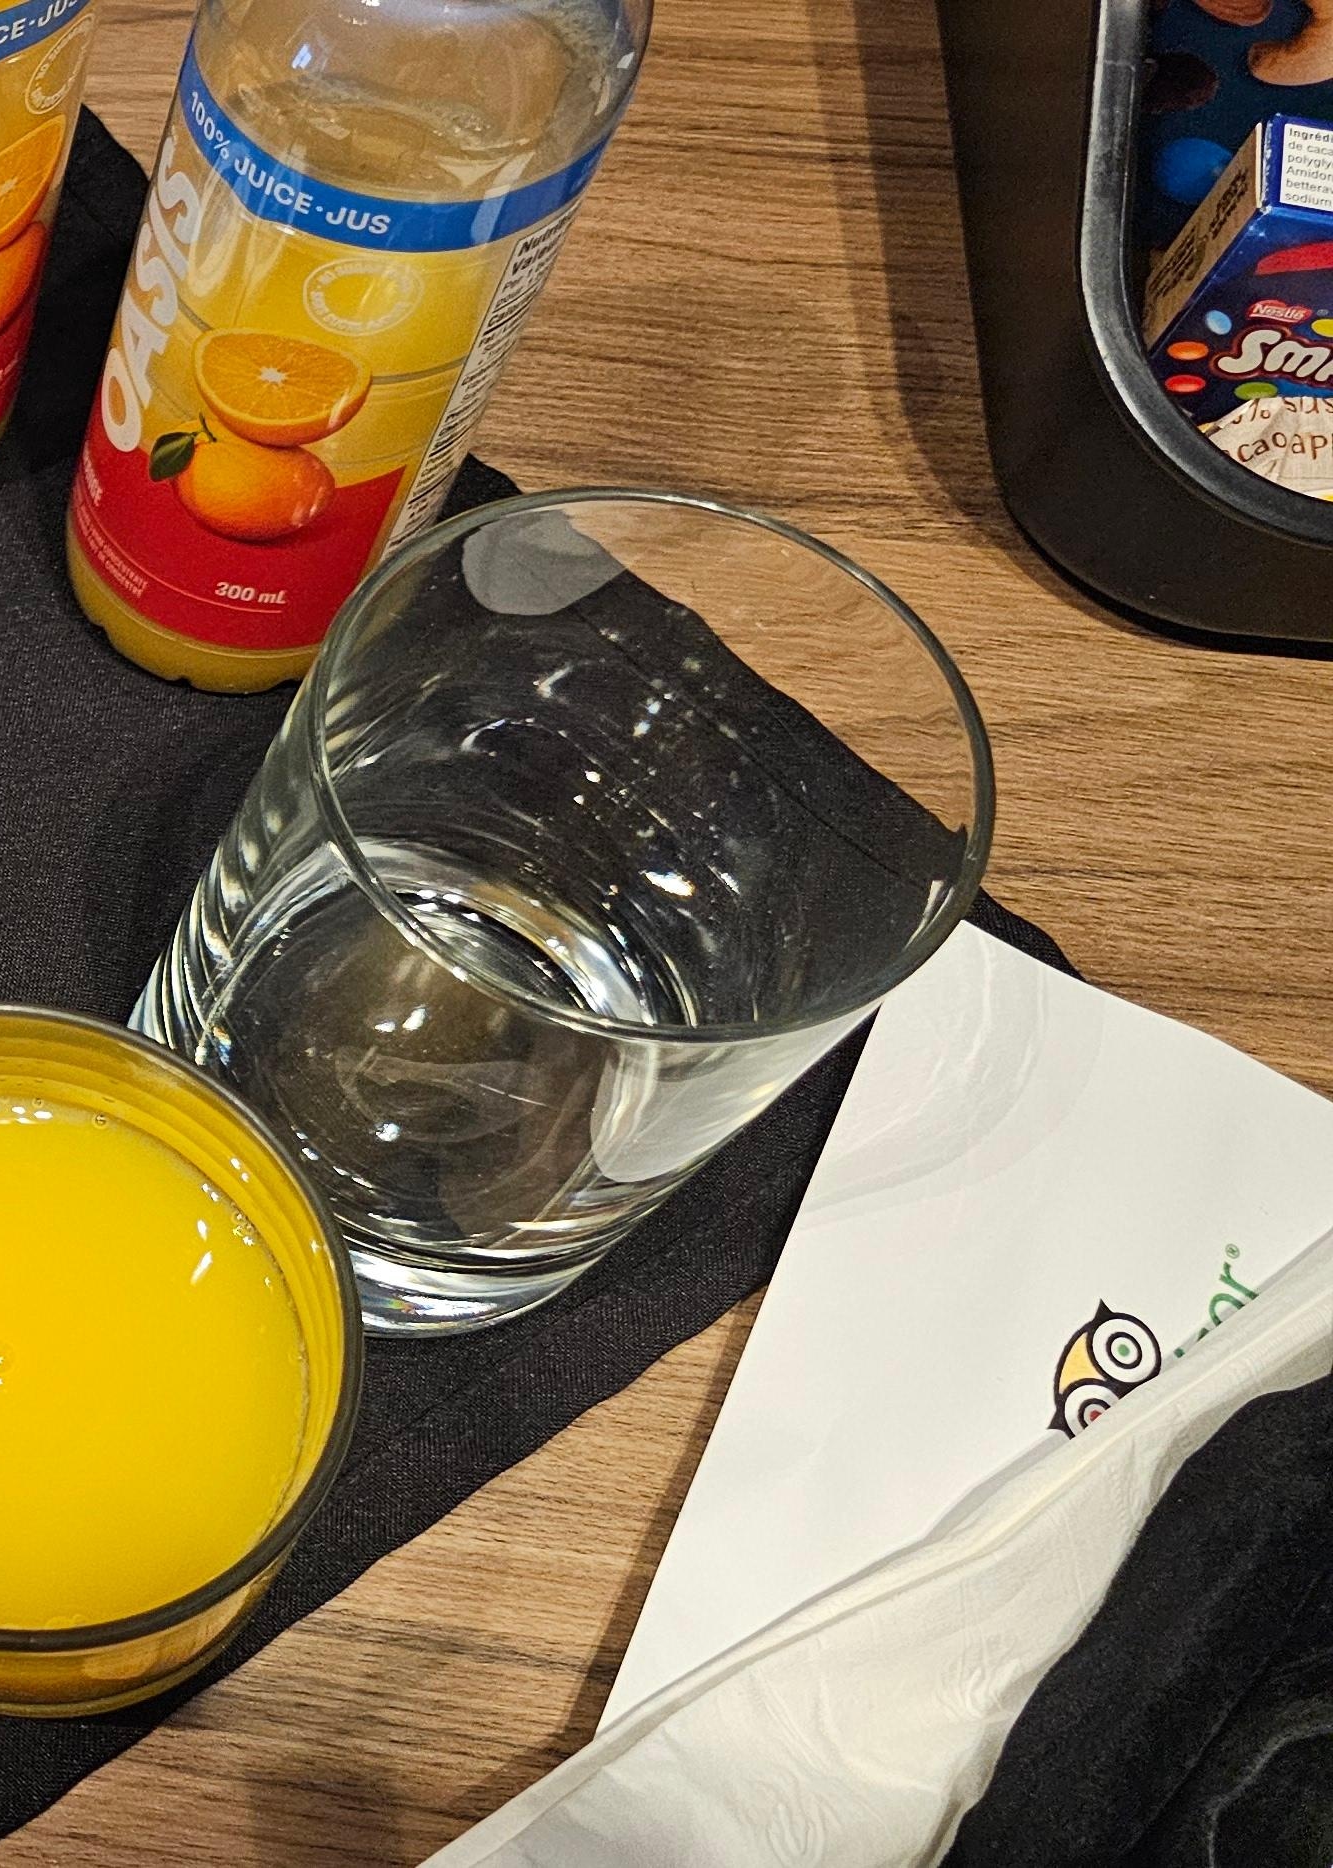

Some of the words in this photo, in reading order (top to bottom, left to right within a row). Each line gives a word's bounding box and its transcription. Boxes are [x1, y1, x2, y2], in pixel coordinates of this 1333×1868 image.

[190, 91, 231, 160] 100%
[233, 157, 314, 215] JUICE
[325, 207, 392, 235] JUS
[100, 136, 201, 453] OASIS
[214, 581, 255, 602] 300
[257, 589, 287, 605] mL
